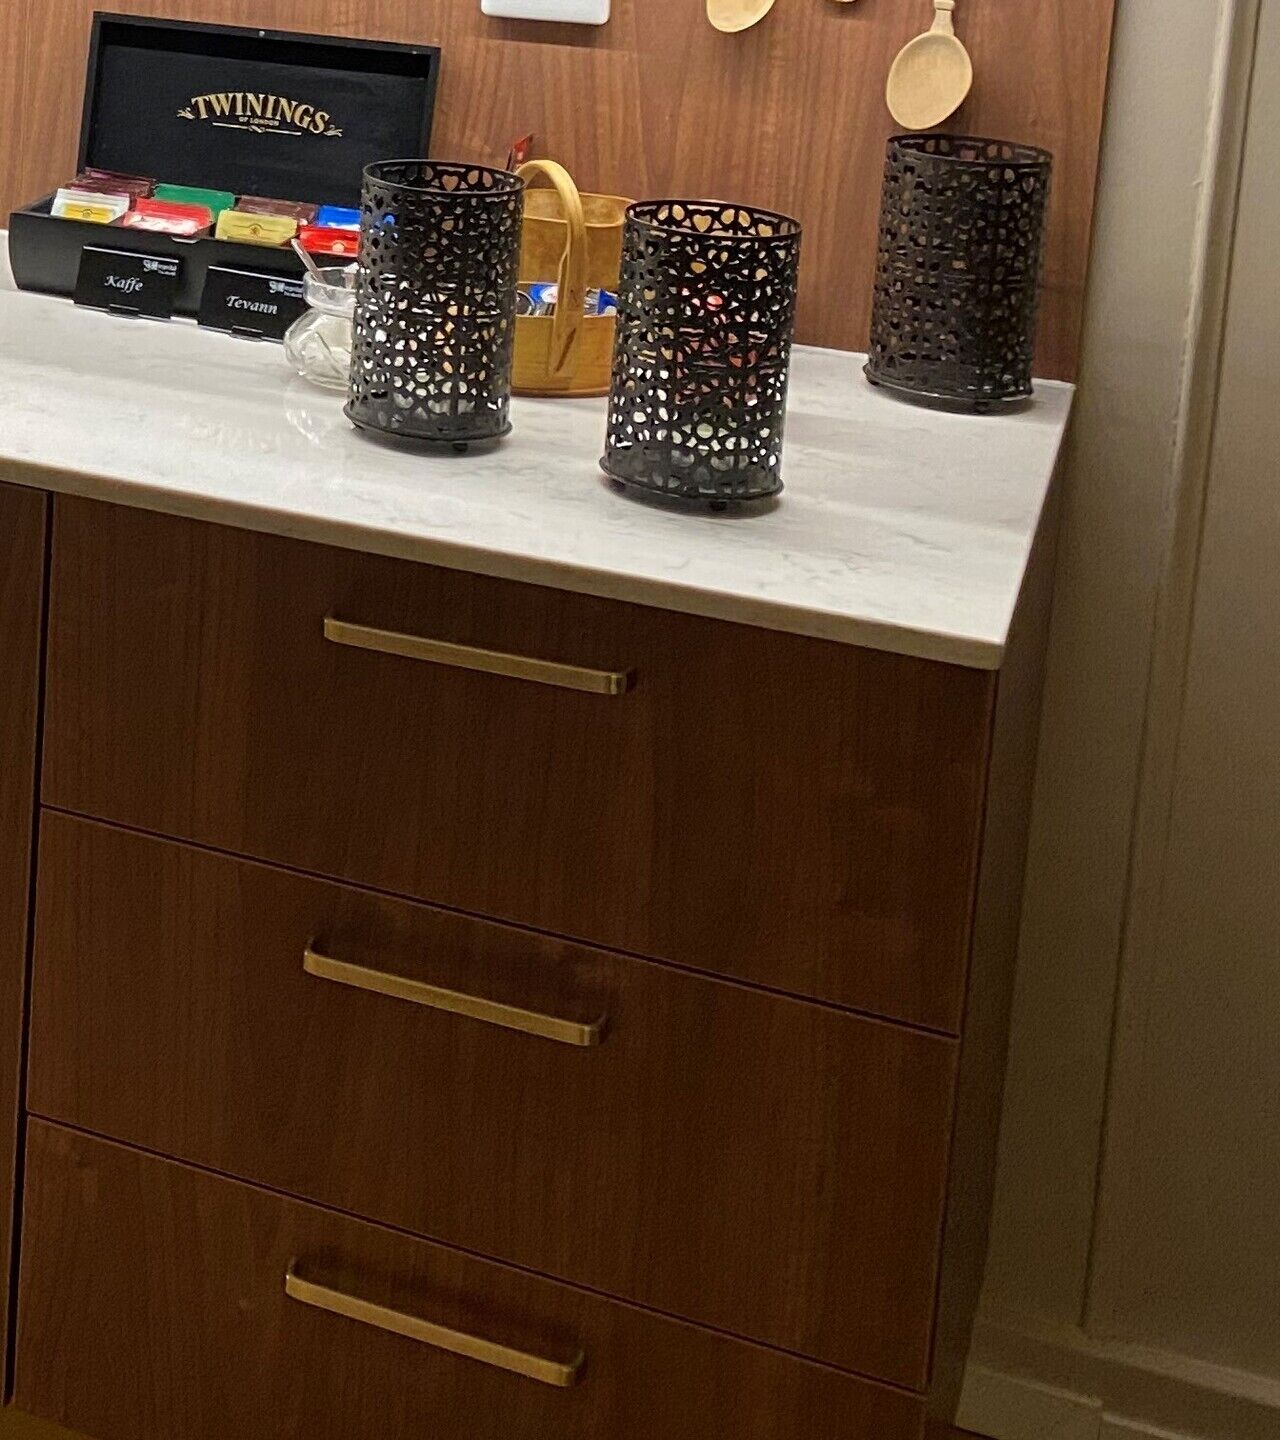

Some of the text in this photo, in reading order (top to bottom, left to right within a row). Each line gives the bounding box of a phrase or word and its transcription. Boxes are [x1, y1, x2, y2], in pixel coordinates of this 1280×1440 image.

[191, 92, 330, 134] TWININGS
[104, 274, 144, 294] Kaffe
[225, 295, 278, 316] Tevann
